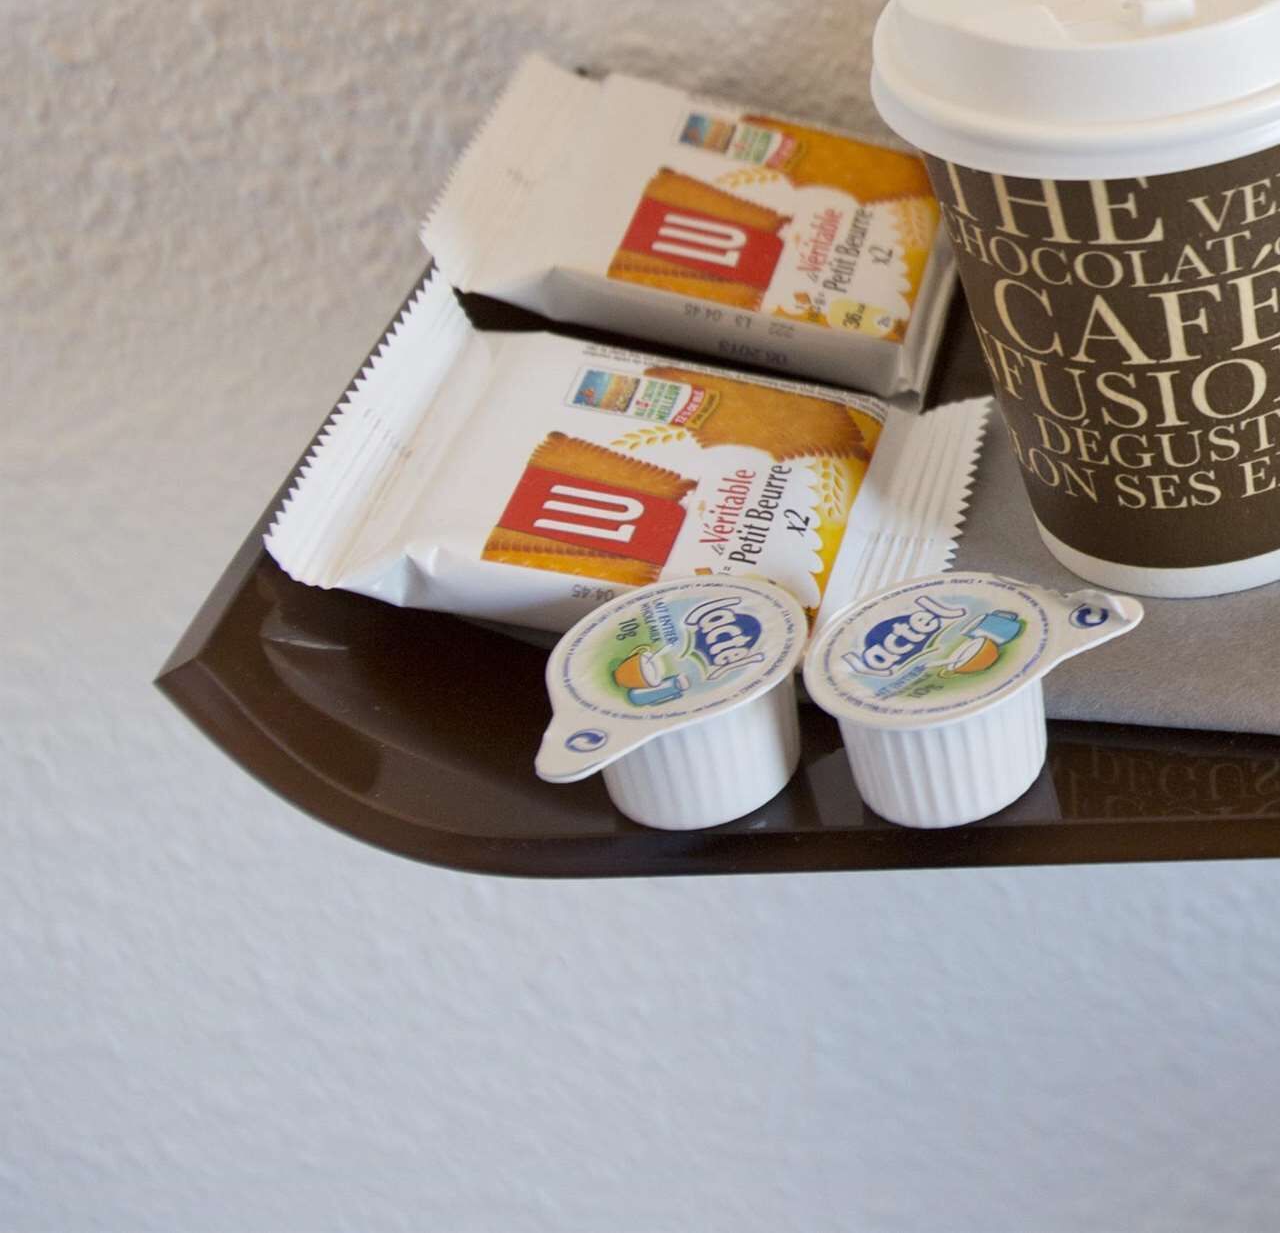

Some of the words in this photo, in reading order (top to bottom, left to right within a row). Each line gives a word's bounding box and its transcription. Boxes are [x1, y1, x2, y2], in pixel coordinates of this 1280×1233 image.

[651, 212, 748, 268] LU
[797, 207, 843, 273] Véritable
[835, 206, 873, 259] Beurre
[940, 199, 1252, 289] CHOCOLAT
[822, 253, 858, 294] Petit
[531, 483, 646, 545] LU
[699, 468, 757, 544] Véritable
[744, 464, 793, 523] Beurre
[1116, 469, 1222, 511] SES
[727, 523, 771, 566] Petit
[783, 508, 811, 538] x2
[615, 617, 640, 641] 10g
